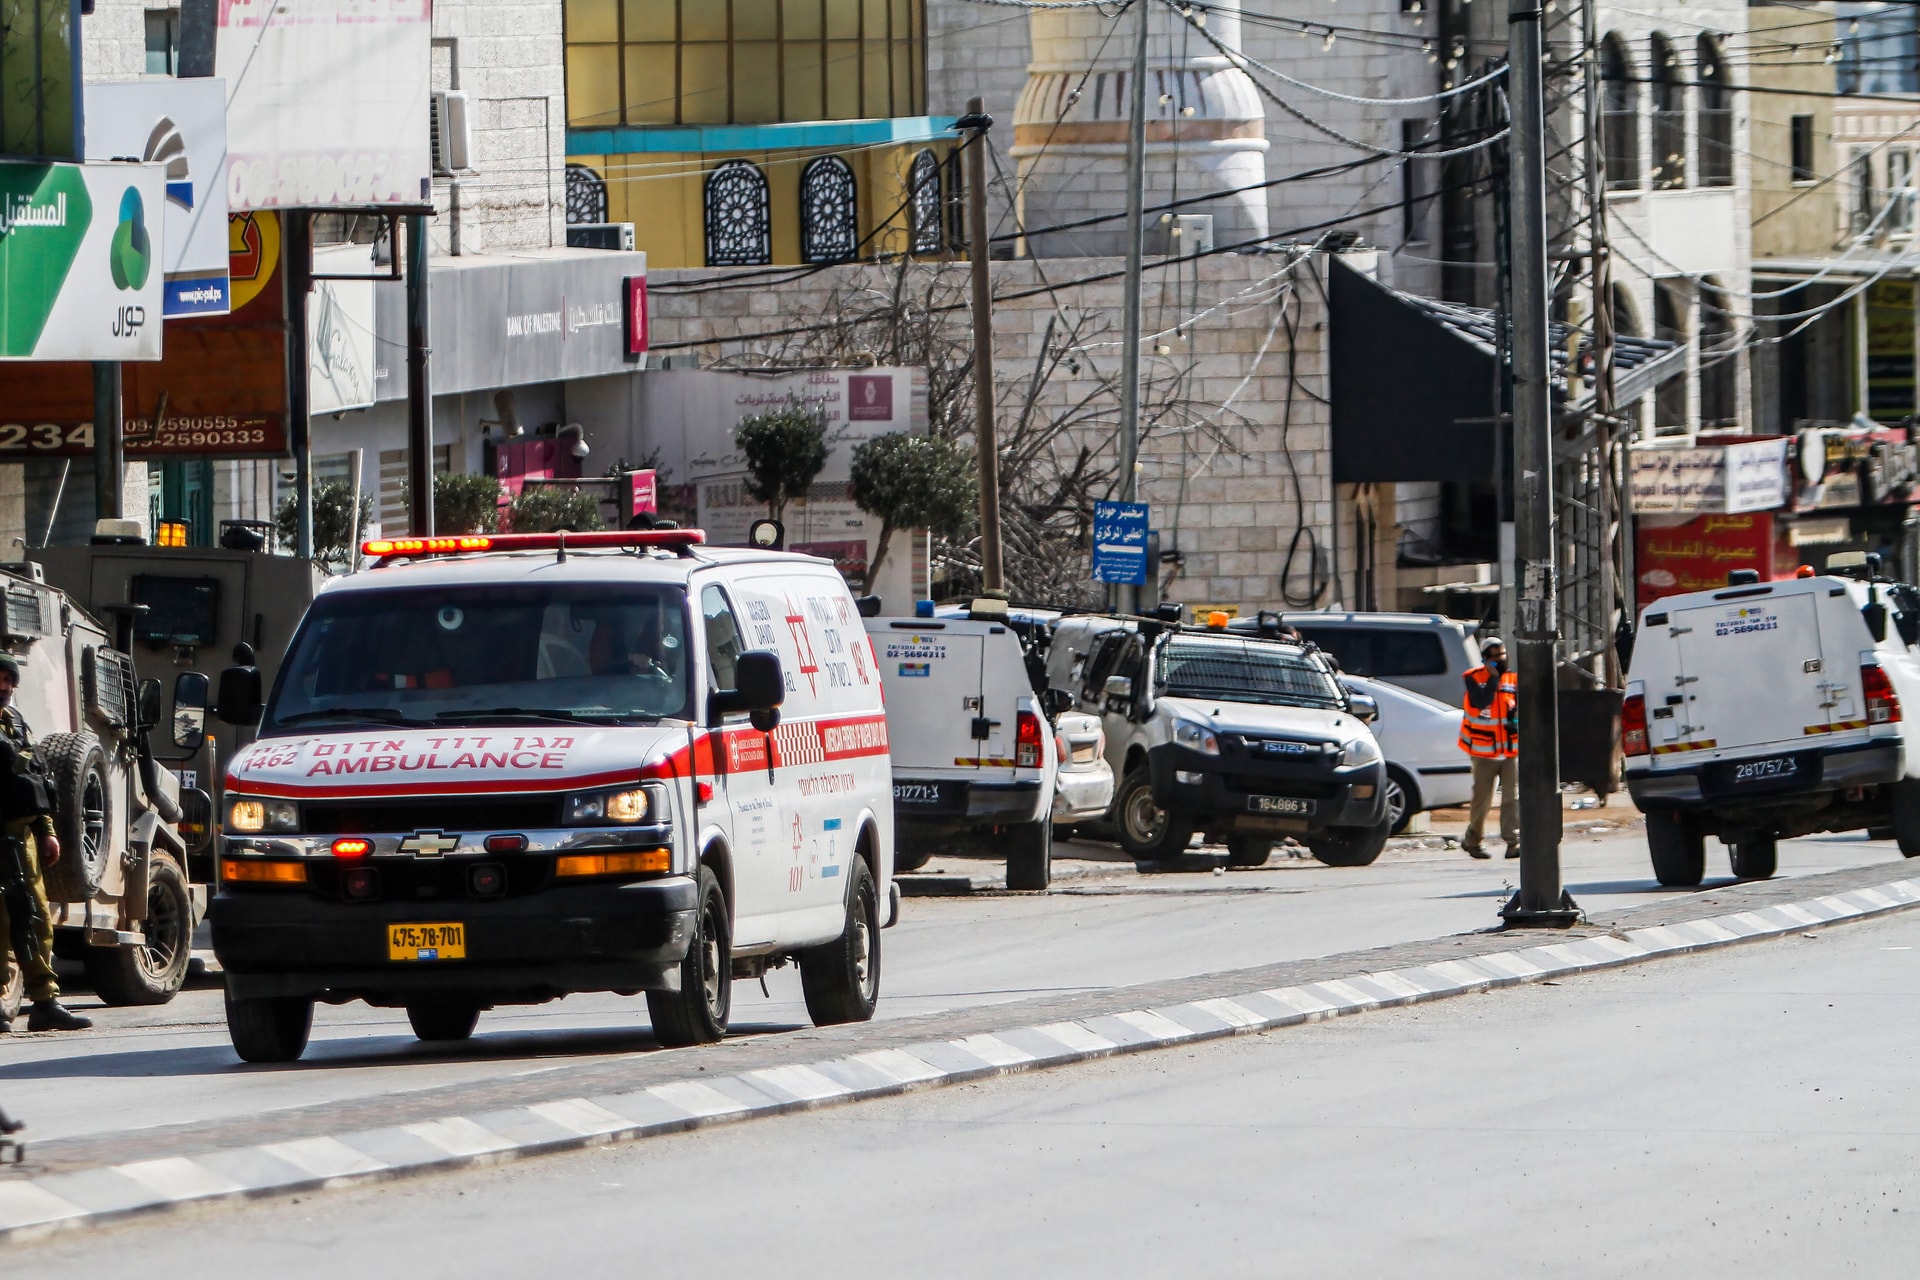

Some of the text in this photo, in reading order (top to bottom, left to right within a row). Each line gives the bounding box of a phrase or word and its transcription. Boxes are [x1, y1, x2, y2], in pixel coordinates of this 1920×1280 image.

[0, 192, 67, 235] المستقبل
[112, 306, 145, 337] جوال
[507, 311, 561, 336] BANK OF PALESTINE
[1716, 622, 1778, 636] 02-5694211
[887, 650, 946, 659] 02-5694211
[313, 737, 575, 757] מגן דוד אדום
[1265, 743, 1305, 754] ISUZU
[244, 751, 298, 773] 1462
[305, 752, 567, 777] AMBULANCE
[789, 865, 803, 892] 101
[393, 927, 461, 947] 475-78-701
